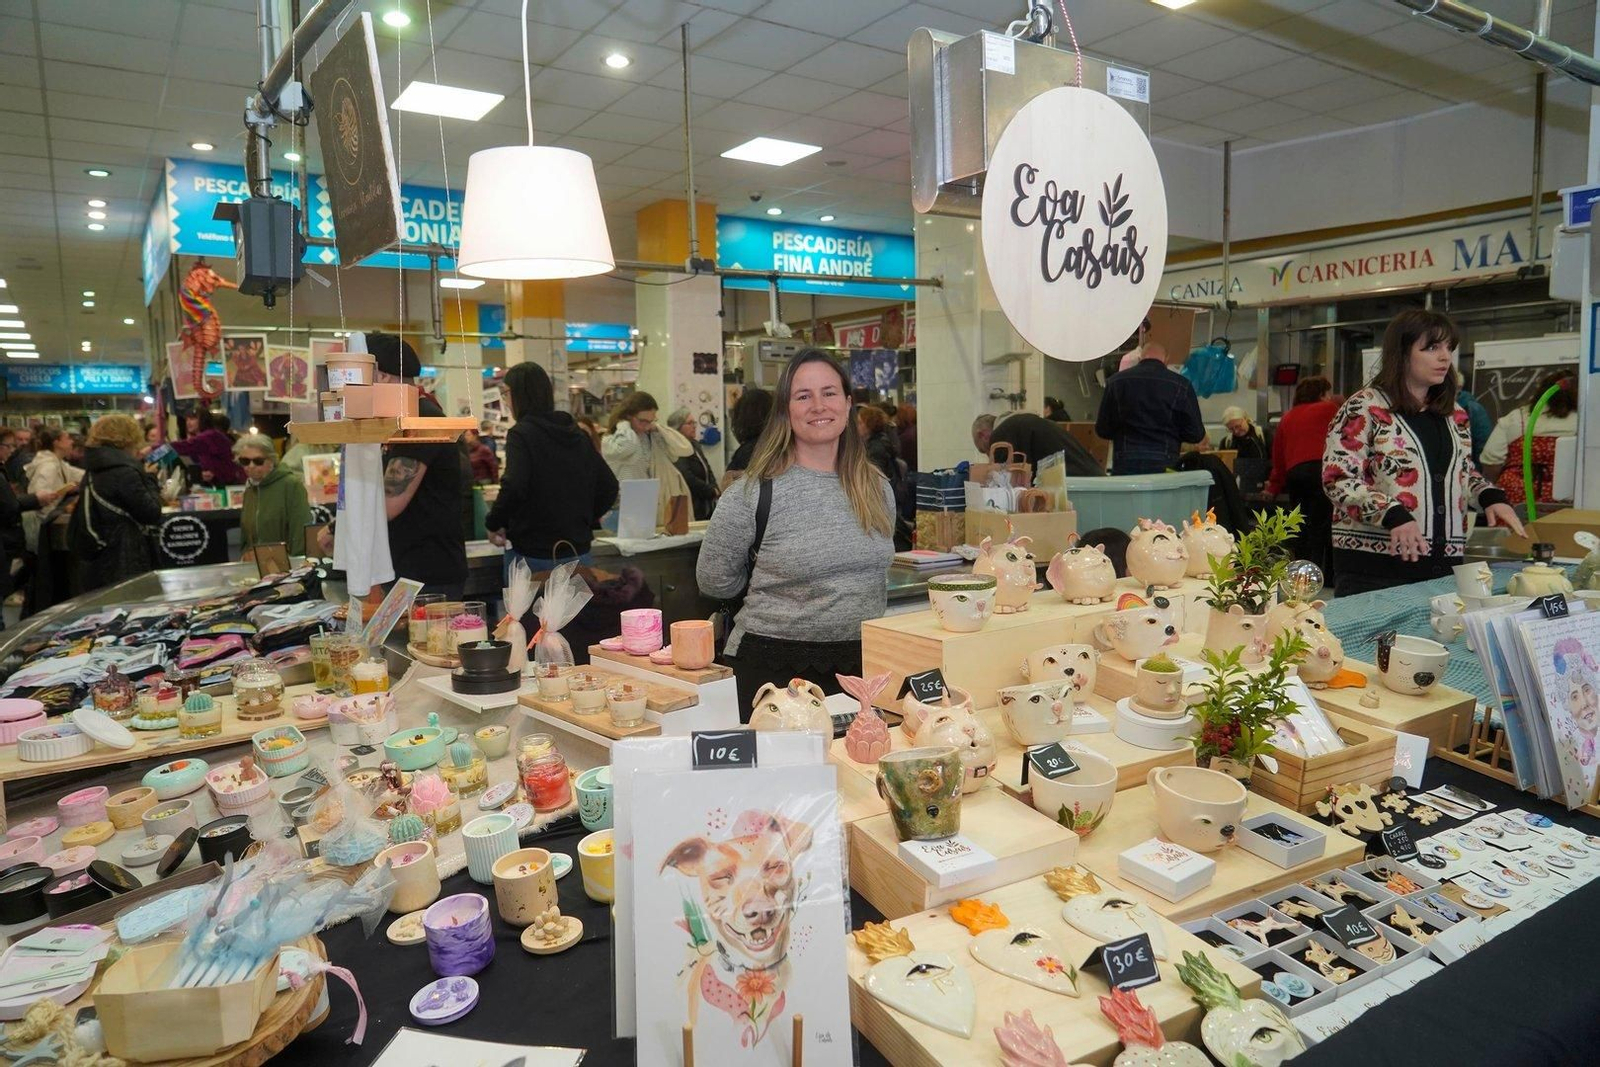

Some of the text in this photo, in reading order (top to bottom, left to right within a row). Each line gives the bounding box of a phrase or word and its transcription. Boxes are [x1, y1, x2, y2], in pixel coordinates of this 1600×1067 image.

[193, 176, 301, 201] PESCARÍA
[1010, 163, 1085, 227] Eva
[773, 231, 873, 257] PESCADERÍA
[1041, 218, 1148, 289] Casais
[773, 253, 873, 277] FINA ANDRÉ
[1297, 248, 1435, 284] CARNICERIA
[1170, 276, 1243, 301] CAÑIZA
[1549, 600, 1566, 614] 15€
[920, 679, 943, 693] 25€
[709, 747, 740, 761] 10€
[1345, 921, 1368, 936] 10€
[1112, 946, 1148, 974] 30€
